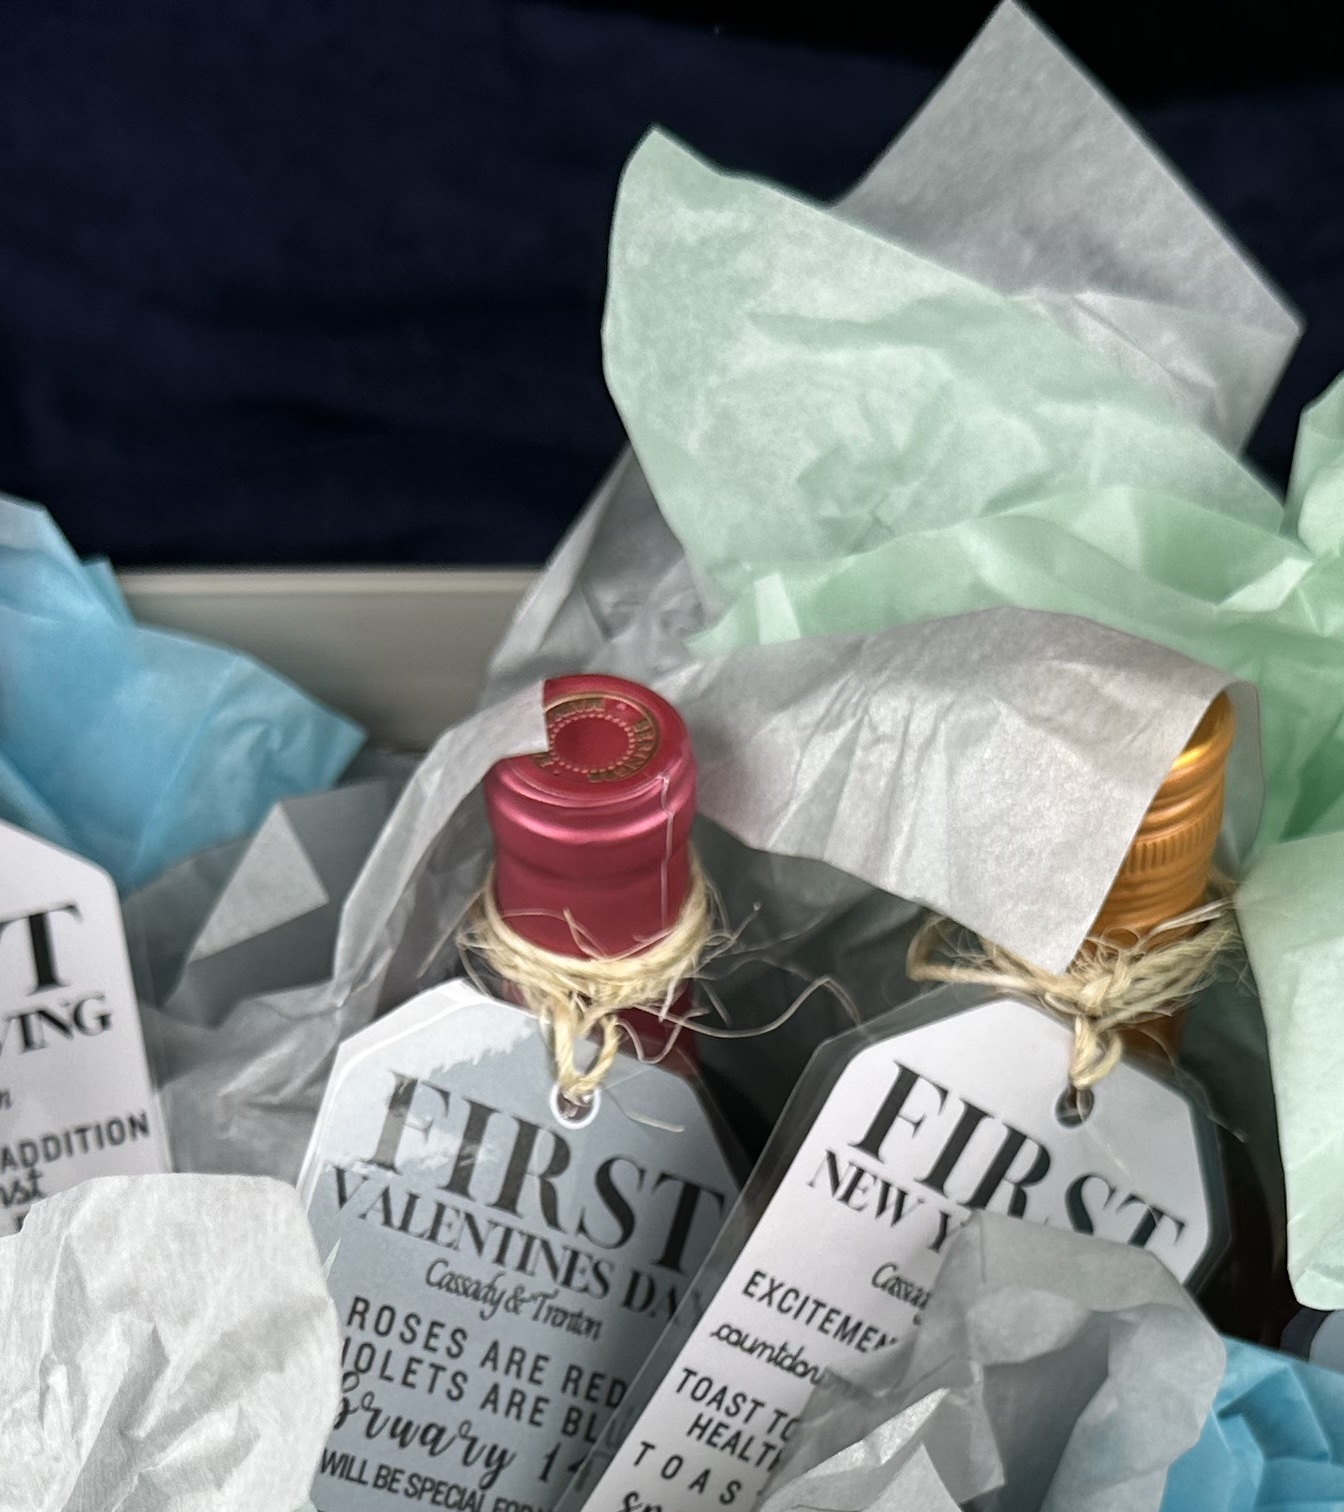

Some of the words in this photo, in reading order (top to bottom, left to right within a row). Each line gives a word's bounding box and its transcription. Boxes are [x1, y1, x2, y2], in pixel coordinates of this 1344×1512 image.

[0, 1110, 151, 1174] ADDITION
[362, 1070, 725, 1275] FIRST
[806, 1149, 925, 1227] NEW
[331, 1167, 614, 1300] VALENTINES
[341, 1338, 469, 1402] IOLETS
[480, 1382, 550, 1428] ARE
[347, 1296, 468, 1361] ROSES
[479, 1338, 551, 1385] ARE
[561, 1364, 628, 1409] RED
[675, 1368, 765, 1424] TOAST
[768, 1407, 799, 1441] TO
[320, 1447, 370, 1486] WILL
[372, 1464, 405, 1494] BE
